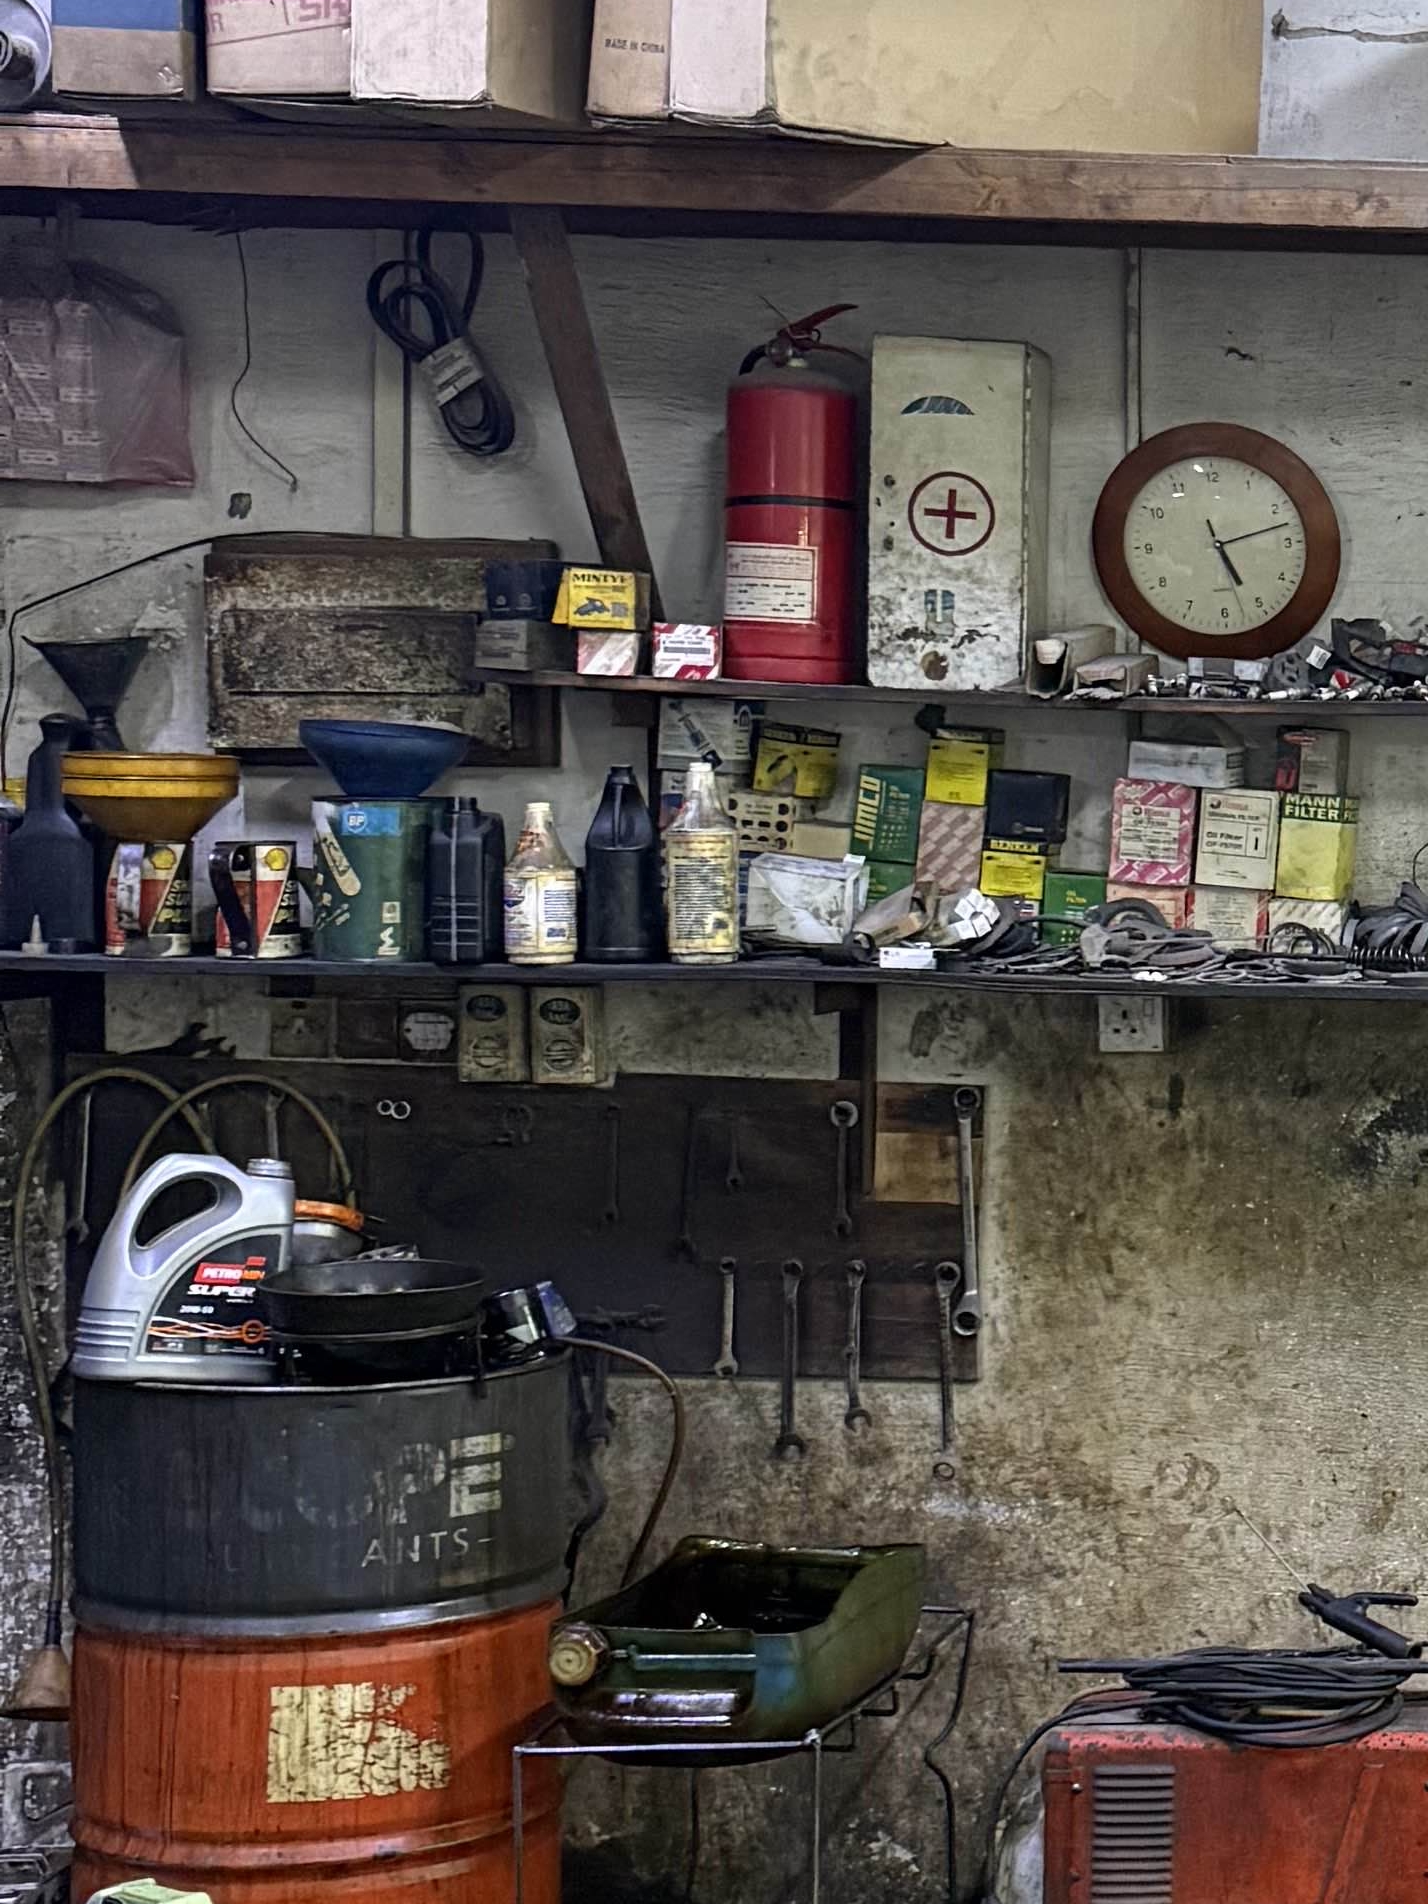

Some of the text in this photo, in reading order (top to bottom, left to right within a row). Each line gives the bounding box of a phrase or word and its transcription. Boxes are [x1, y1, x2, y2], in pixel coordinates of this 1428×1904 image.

[1206, 472, 1219, 483] 12
[1246, 480, 1251, 490] 1
[1150, 507, 1164, 519] 10
[1272, 504, 1279, 514] 2
[1284, 538, 1292, 548] 3
[1144, 544, 1153, 554] 9
[1159, 577, 1167, 587] 8
[1278, 572, 1286, 582] 4
[1185, 600, 1193, 611] 7
[1255, 597, 1263, 608] 5
[1221, 608, 1229, 618] 6
[1286, 793, 1340, 809] MANN
[1284, 804, 1339, 821] FILTER
[348, 815, 364, 826] BP
[187, 1284, 257, 1297] SUPER
